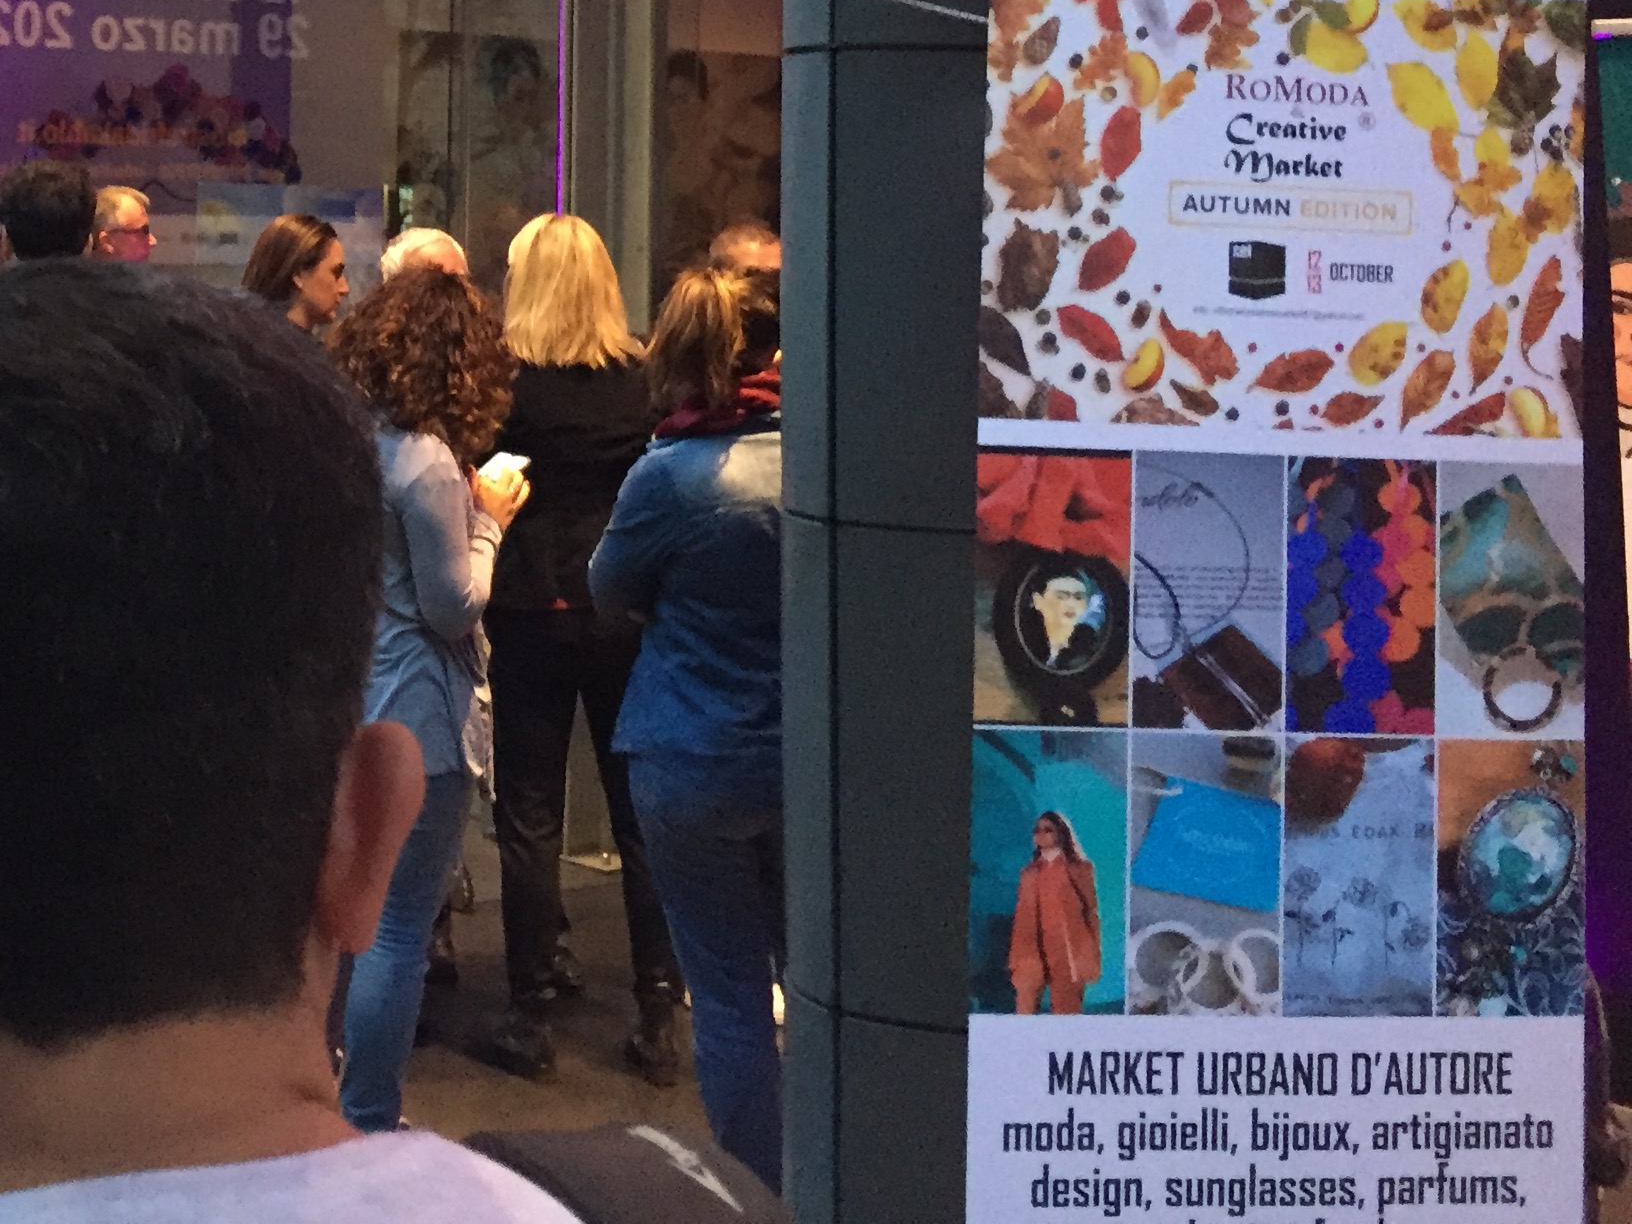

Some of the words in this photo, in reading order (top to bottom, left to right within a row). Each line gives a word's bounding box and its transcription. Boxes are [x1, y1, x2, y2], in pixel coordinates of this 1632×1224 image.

[1225, 113, 1346, 145] Creative
[1224, 149, 1343, 183] Market
[1182, 194, 1290, 216] AUTUMN
[1300, 199, 1397, 220] EDITION
[1330, 262, 1393, 283] OCTOBER
[1047, 1051, 1184, 1096] MARKET
[1197, 1051, 1337, 1097] URBANO
[1350, 1051, 1514, 1096] D'AUTORE
[1002, 1109, 1104, 1156] moda,
[1117, 1111, 1238, 1160] gioielli,
[1250, 1107, 1360, 1160] bijoux,
[1371, 1107, 1554, 1159] artigianato
[1030, 1164, 1152, 1216] design,
[1165, 1163, 1365, 1217] sunglasses,
[1377, 1162, 1527, 1215] parfums,
